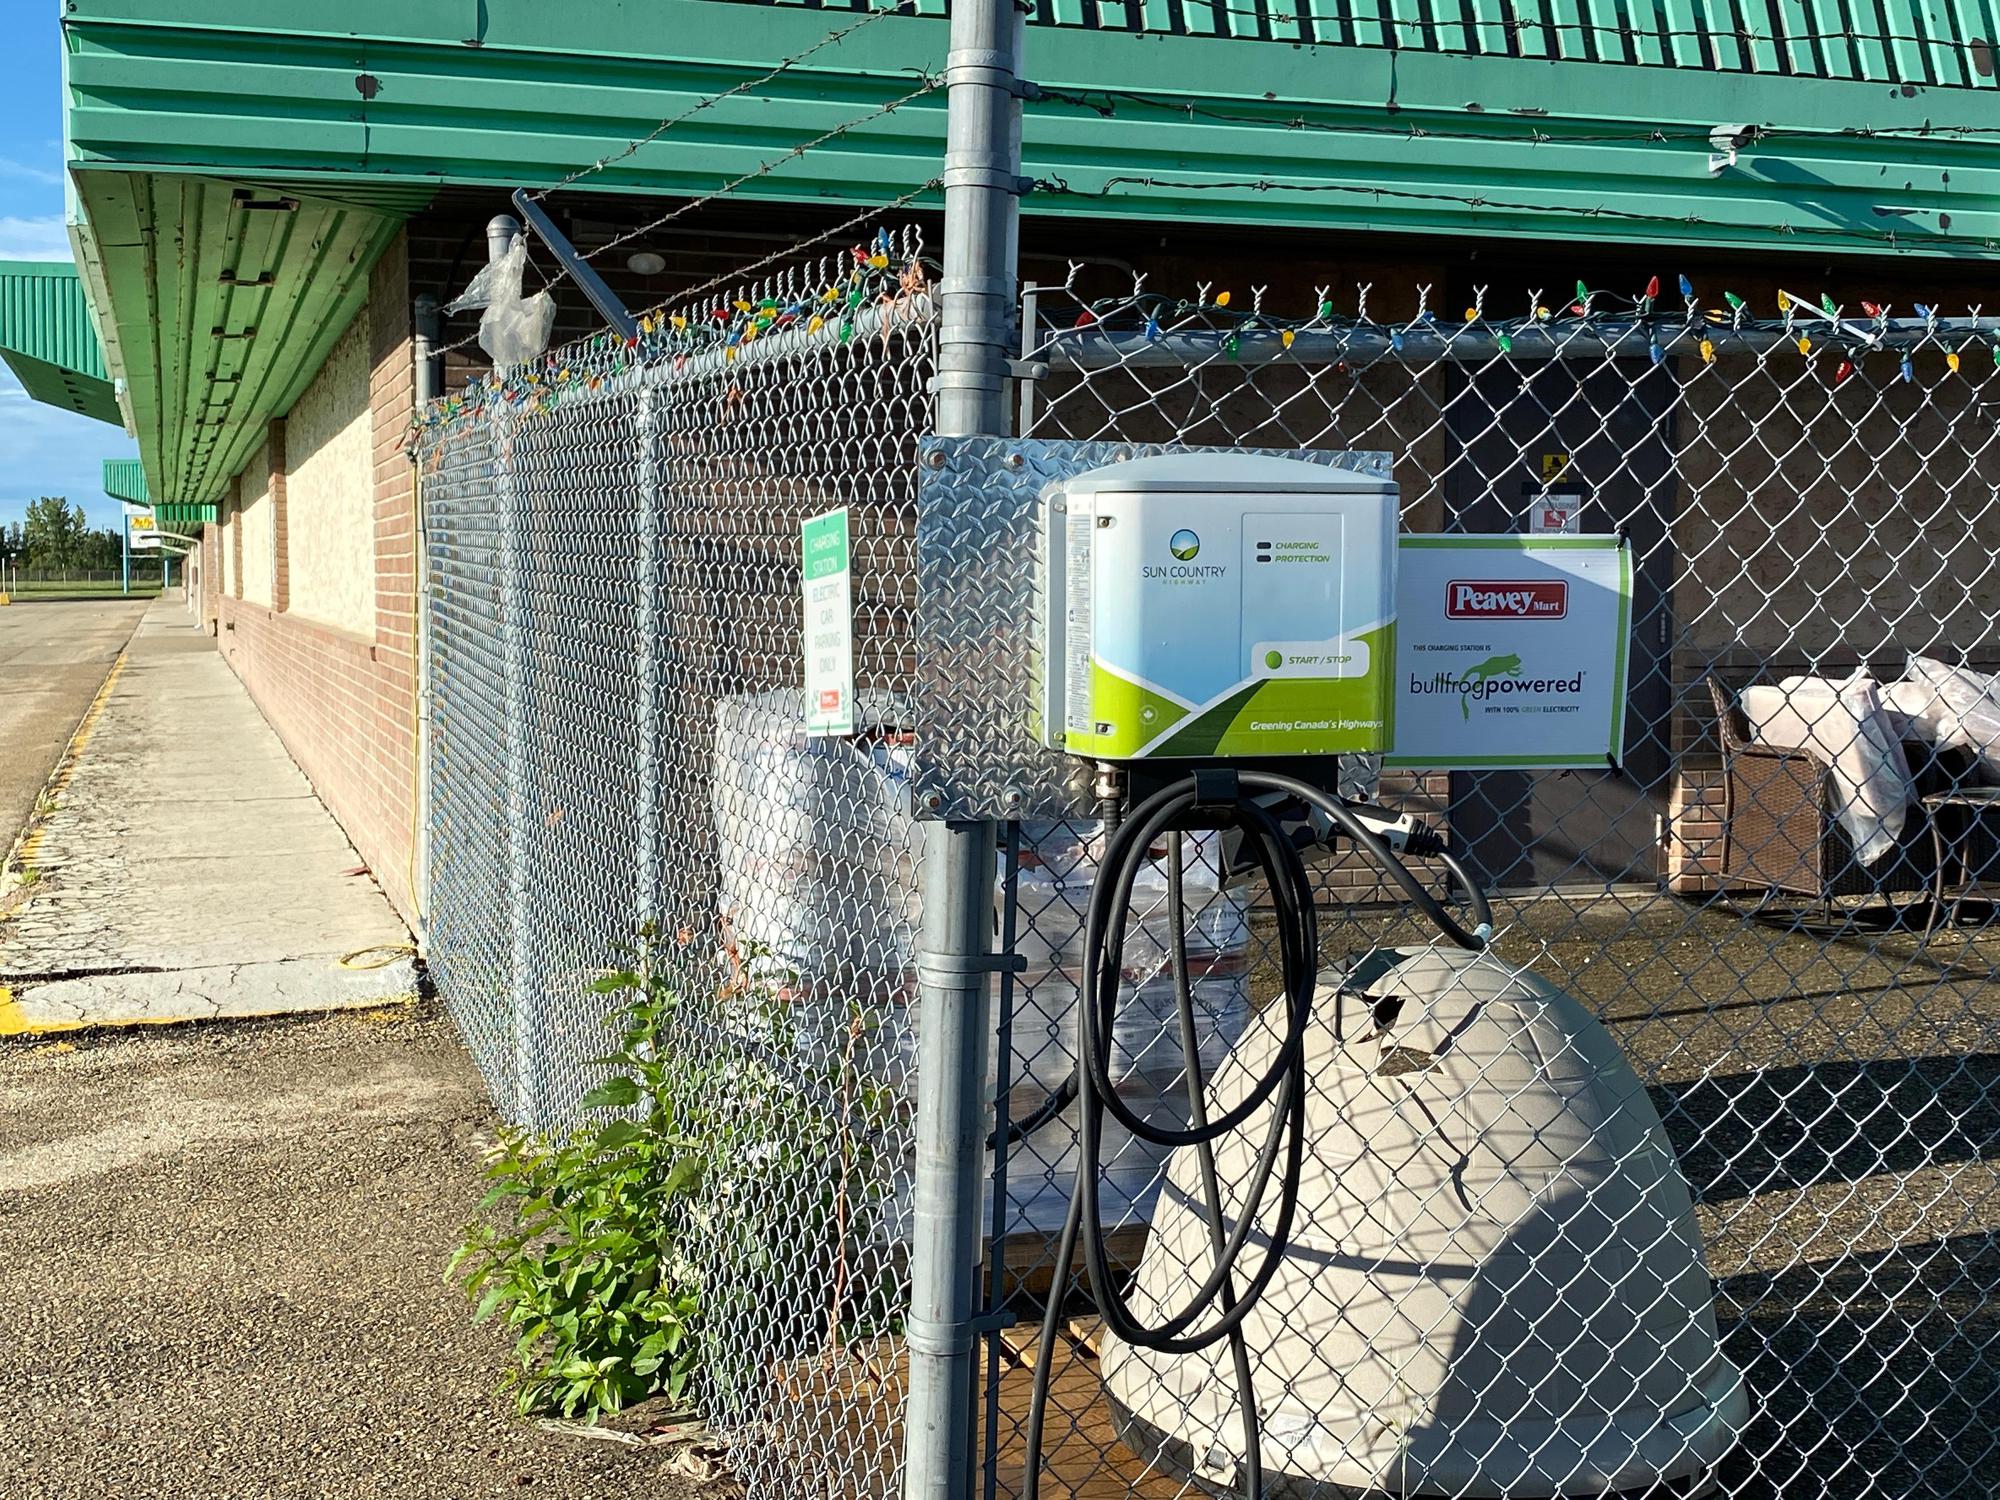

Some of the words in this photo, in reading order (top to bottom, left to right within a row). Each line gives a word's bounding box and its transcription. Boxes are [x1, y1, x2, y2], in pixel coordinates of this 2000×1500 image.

[1275, 542, 1319, 550] CHARGING
[1275, 555, 1330, 563] PROTECTION
[813, 556, 838, 577] STATION
[1142, 566, 1167, 578] SUN
[1170, 566, 1226, 578] COUNTRY
[1455, 585, 1536, 615] Peavey
[1533, 601, 1560, 611] Mart
[820, 608, 834, 625] CAR
[819, 656, 836, 673] ONLY
[1288, 656, 1318, 665] START
[1327, 655, 1352, 664] STOP
[1250, 721, 1293, 731] Greening
[1294, 720, 1338, 730] Canada's
[1338, 720, 1384, 730] Highways
